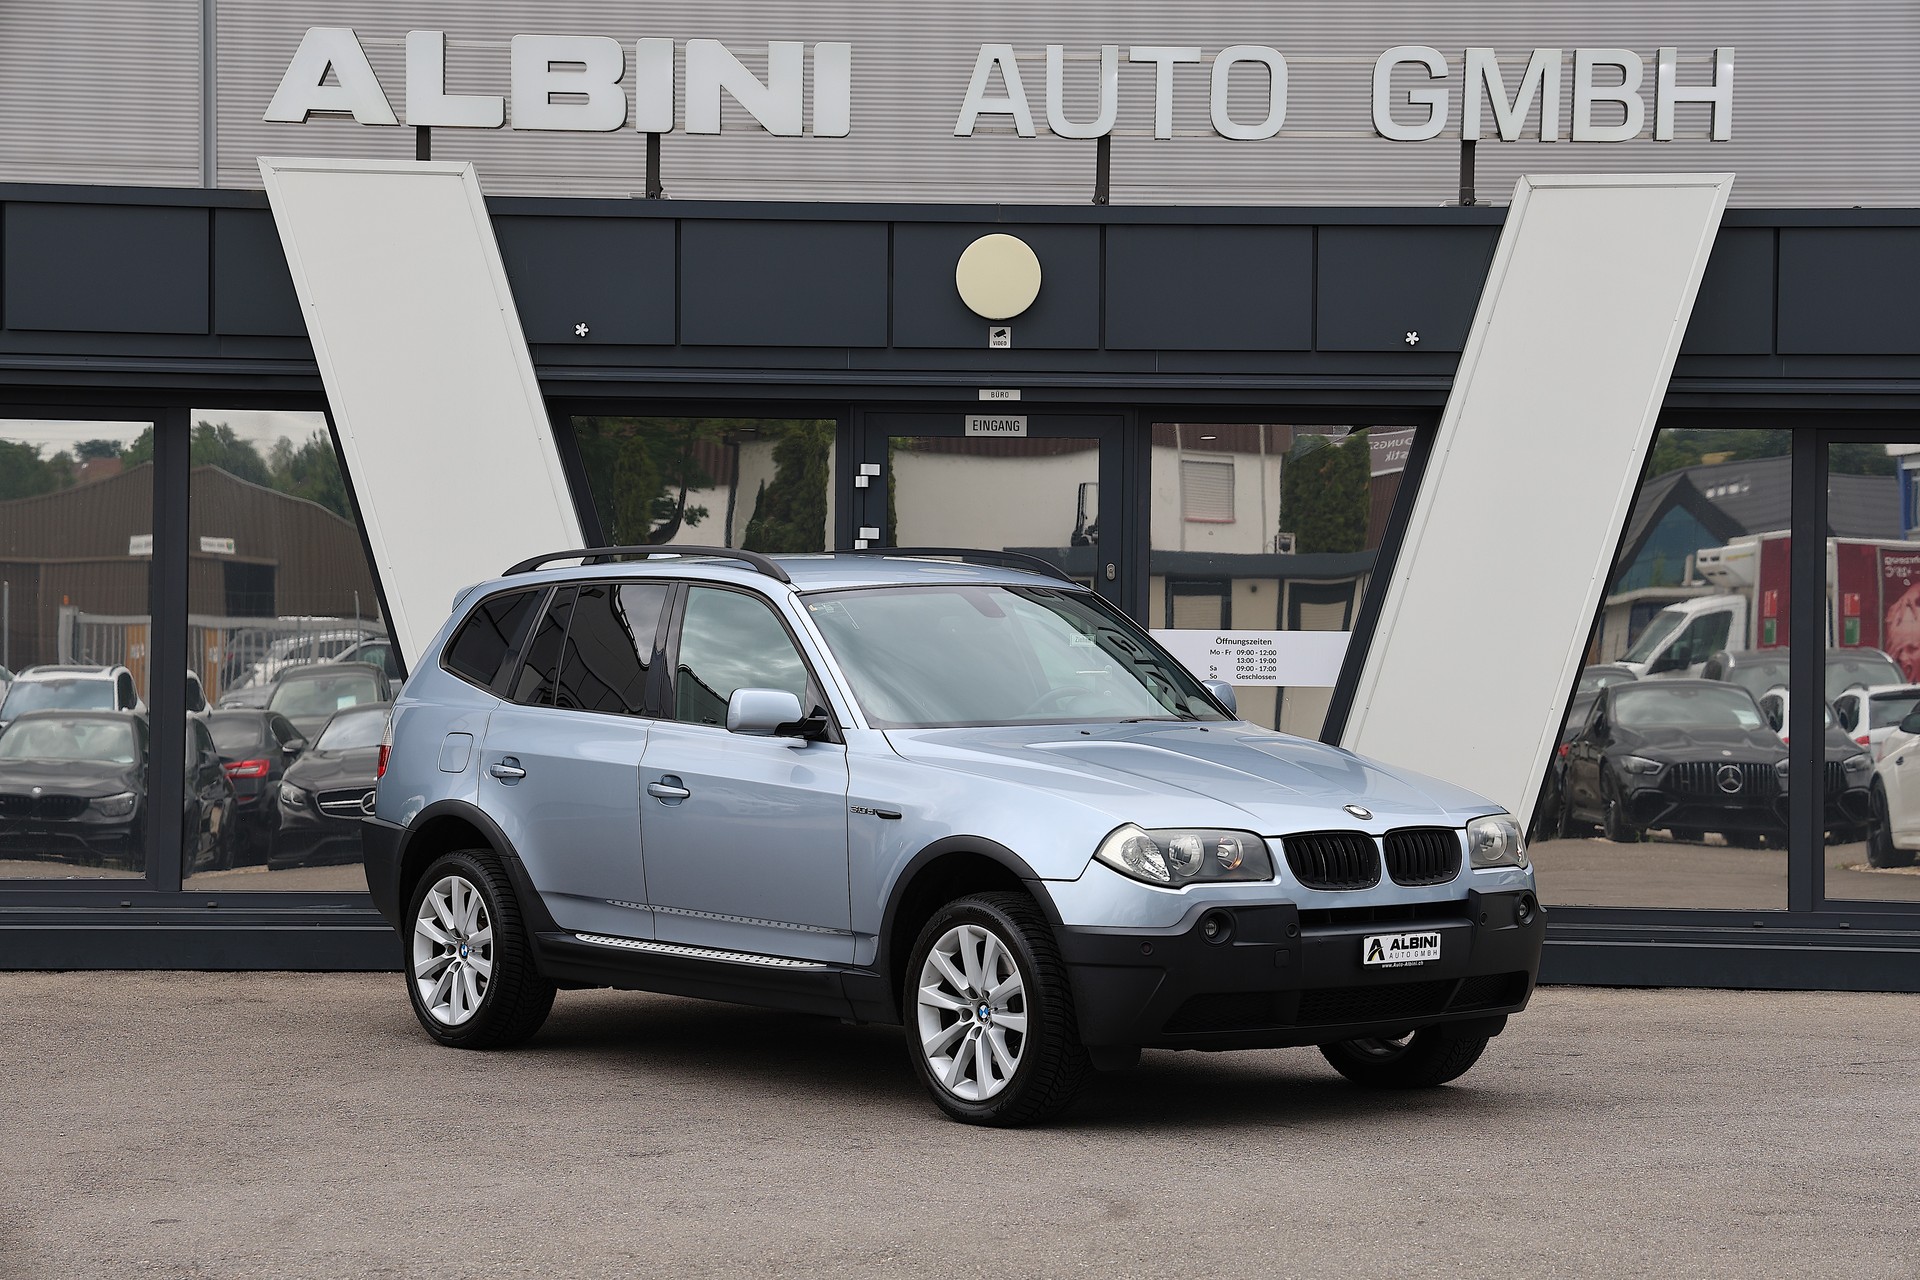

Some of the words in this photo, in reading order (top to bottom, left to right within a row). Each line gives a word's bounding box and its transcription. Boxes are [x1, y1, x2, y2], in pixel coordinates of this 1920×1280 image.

[263, 27, 851, 137] ALBINI
[953, 44, 1288, 141] AUTO
[1371, 45, 1736, 142] GMBH
[973, 420, 1020, 431] EINGANG
[1216, 636, 1272, 646] Öffnungszeiten
[1390, 935, 1438, 951] ALBINI
[1389, 951, 1411, 959] AUTO
